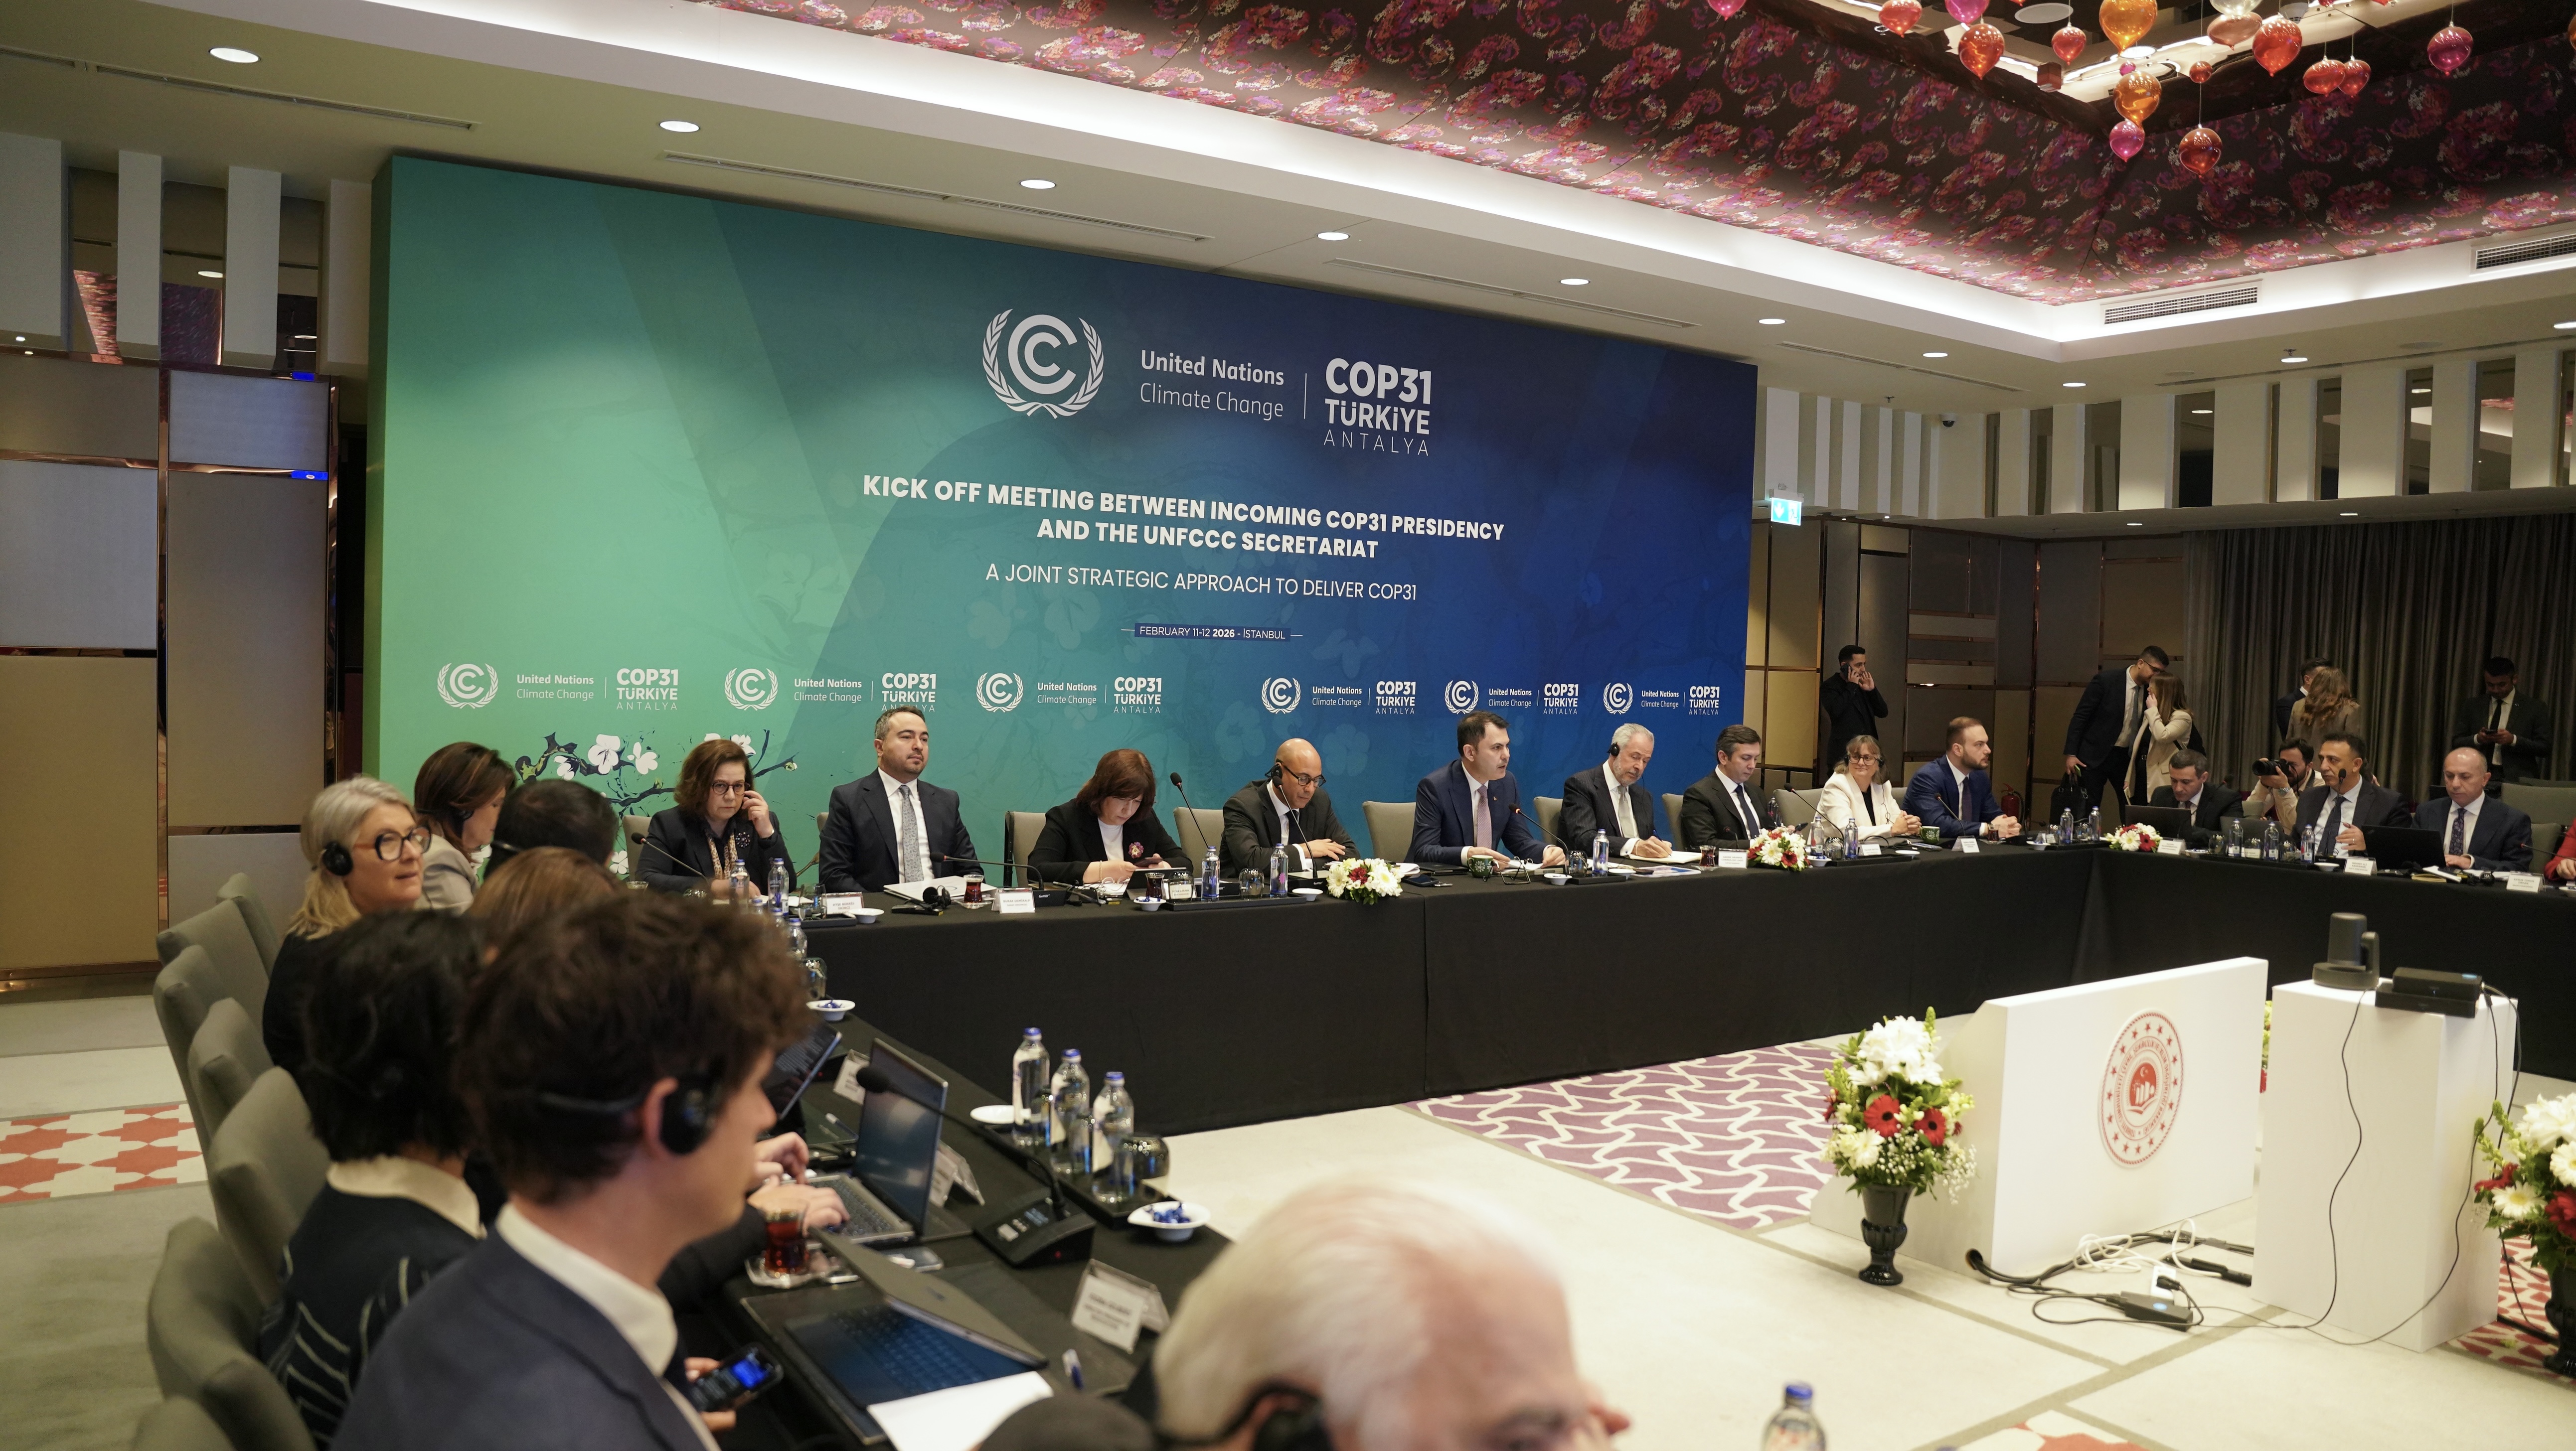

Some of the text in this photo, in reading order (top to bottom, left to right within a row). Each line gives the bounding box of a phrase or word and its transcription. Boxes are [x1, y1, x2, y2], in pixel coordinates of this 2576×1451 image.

[1140, 350, 1285, 386] United Nations
[1325, 357, 1432, 405] COP31
[1140, 383, 1284, 421] Climate Change
[1323, 429, 1429, 456] ANTALYA
[863, 475, 1504, 541] KICK OFF MEETING BETWEEN INCOMING COP31 PRESIDENCY
[1037, 519, 1378, 558] AND THE UNFCCC SECRETARIAT
[985, 563, 1417, 600] A JOINT STRATEGIC APPROACH TO DELIVER COP31
[1140, 626, 1190, 637] FEBRUARY
[1193, 628, 1210, 637] 11-12
[1213, 629, 1235, 638] 2026
[1243, 628, 1285, 639] İSTANBUL
[517, 674, 594, 685] United Nations
[617, 668, 678, 686] COP31
[795, 678, 862, 688] United Nations
[882, 673, 936, 689] COP31
[1037, 682, 1097, 691] United Nations
[1114, 677, 1162, 692] COP31
[1376, 681, 1416, 695] COP31
[1544, 683, 1579, 697] COP31
[517, 689, 594, 701] Climate Change
[795, 692, 862, 704] Climate Change
[1690, 686, 1720, 698] COP31
[616, 702, 677, 710] ANTALYA
[1037, 695, 1096, 706] Climate Change
[1338, 698, 1362, 707] Change
[1511, 700, 1531, 708] Change
